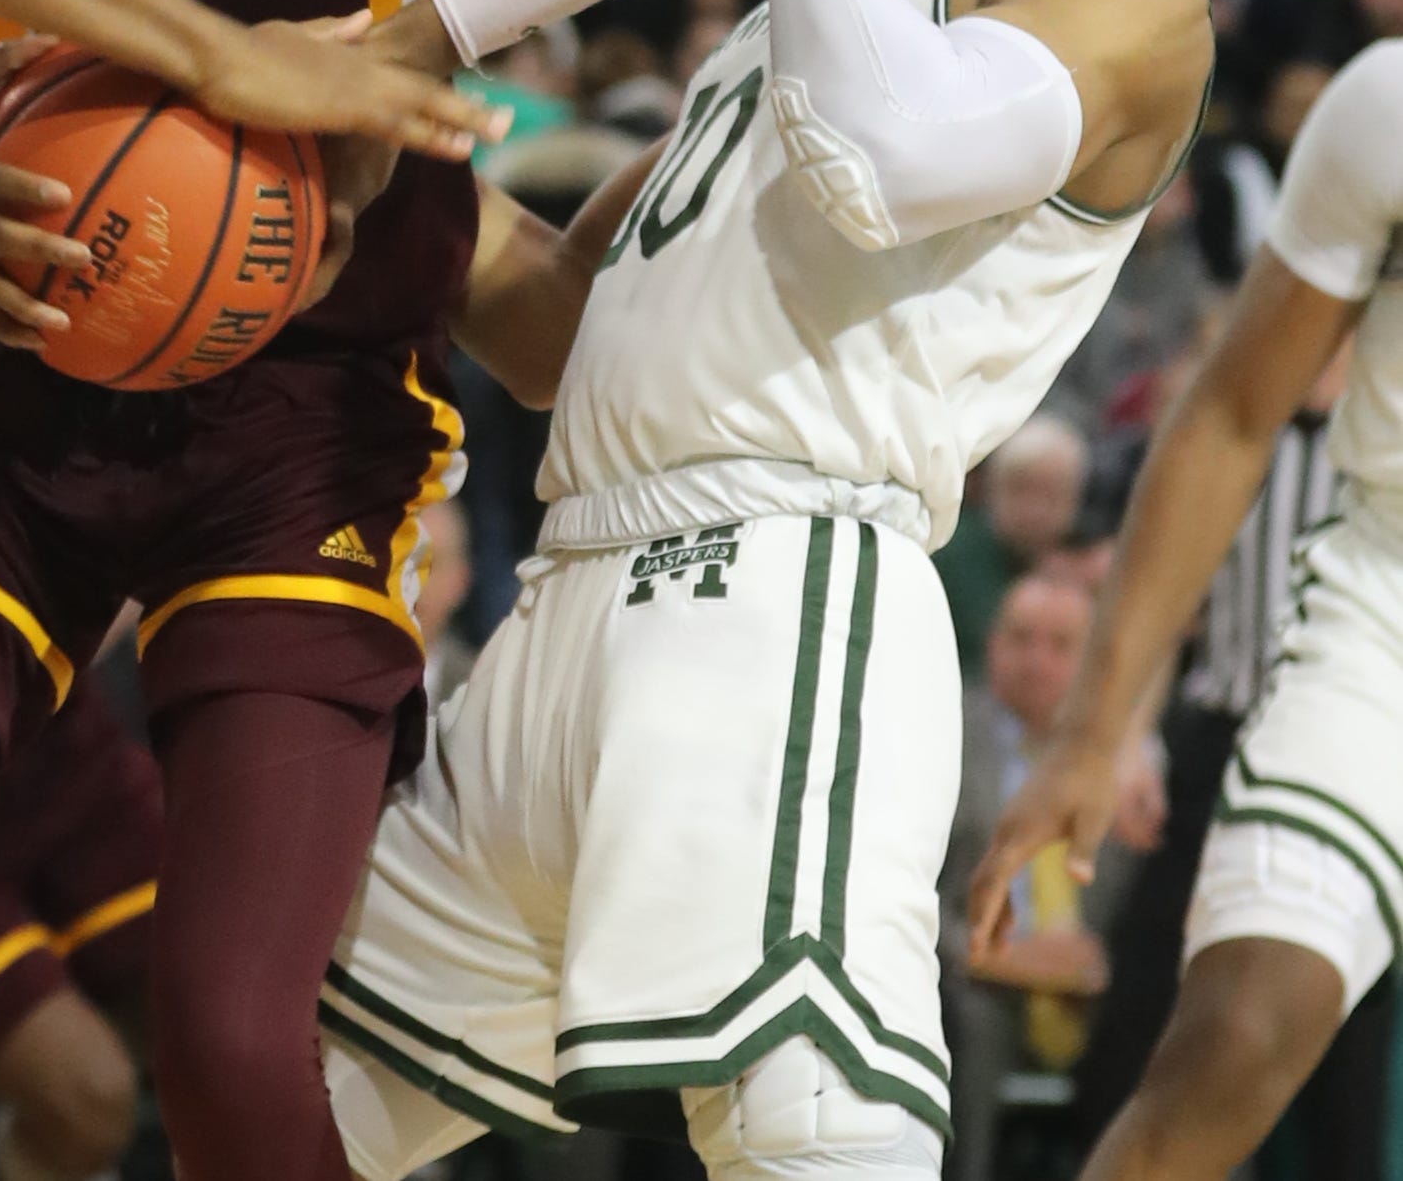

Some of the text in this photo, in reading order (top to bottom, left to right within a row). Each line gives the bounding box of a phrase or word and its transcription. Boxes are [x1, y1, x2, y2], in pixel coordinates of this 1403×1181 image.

[235, 178, 296, 285] THE
[318, 545, 376, 568] adidas
[637, 543, 731, 576] JASPERS
